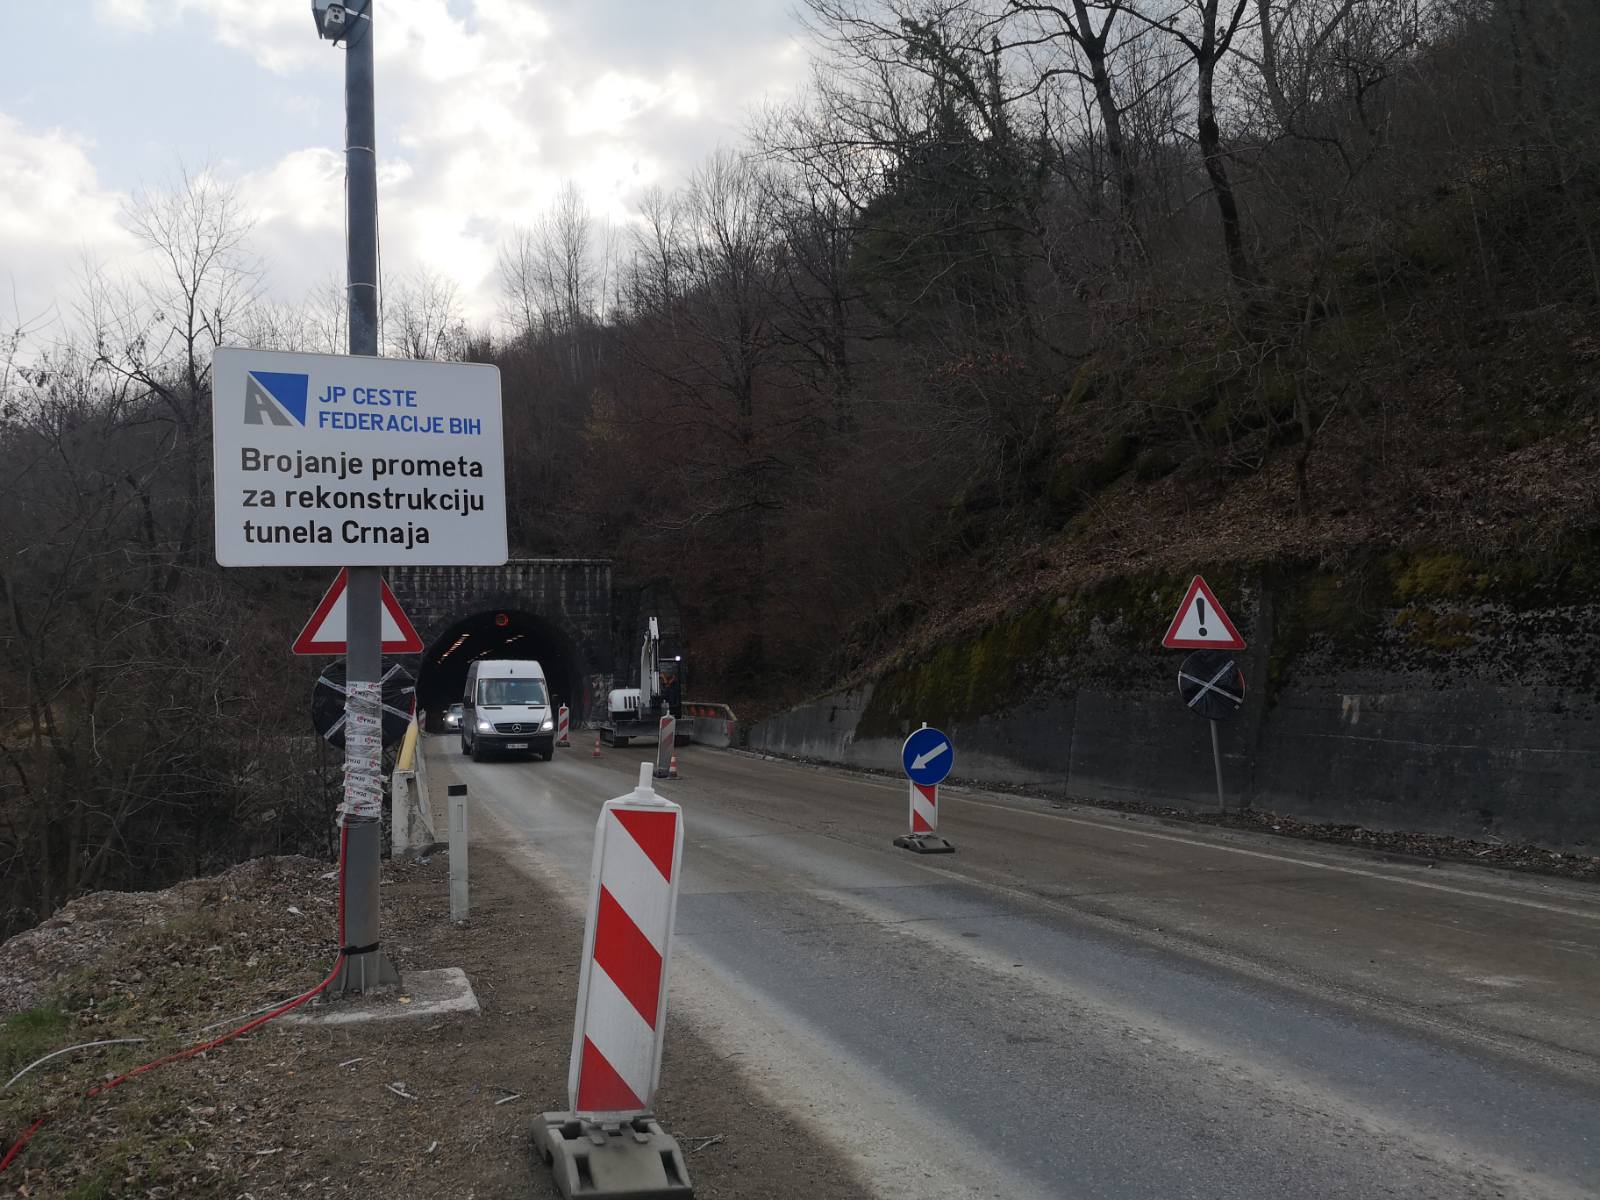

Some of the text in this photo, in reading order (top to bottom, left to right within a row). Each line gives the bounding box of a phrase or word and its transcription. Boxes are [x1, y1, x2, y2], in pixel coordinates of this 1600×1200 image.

[319, 386, 417, 407] JP CESTE
[319, 411, 481, 435] FEDERACIJE BIH
[242, 448, 483, 480] Brojanje prometa
[243, 486, 484, 516] za rekonstrukciju
[243, 520, 429, 550] tunela Crnaja
